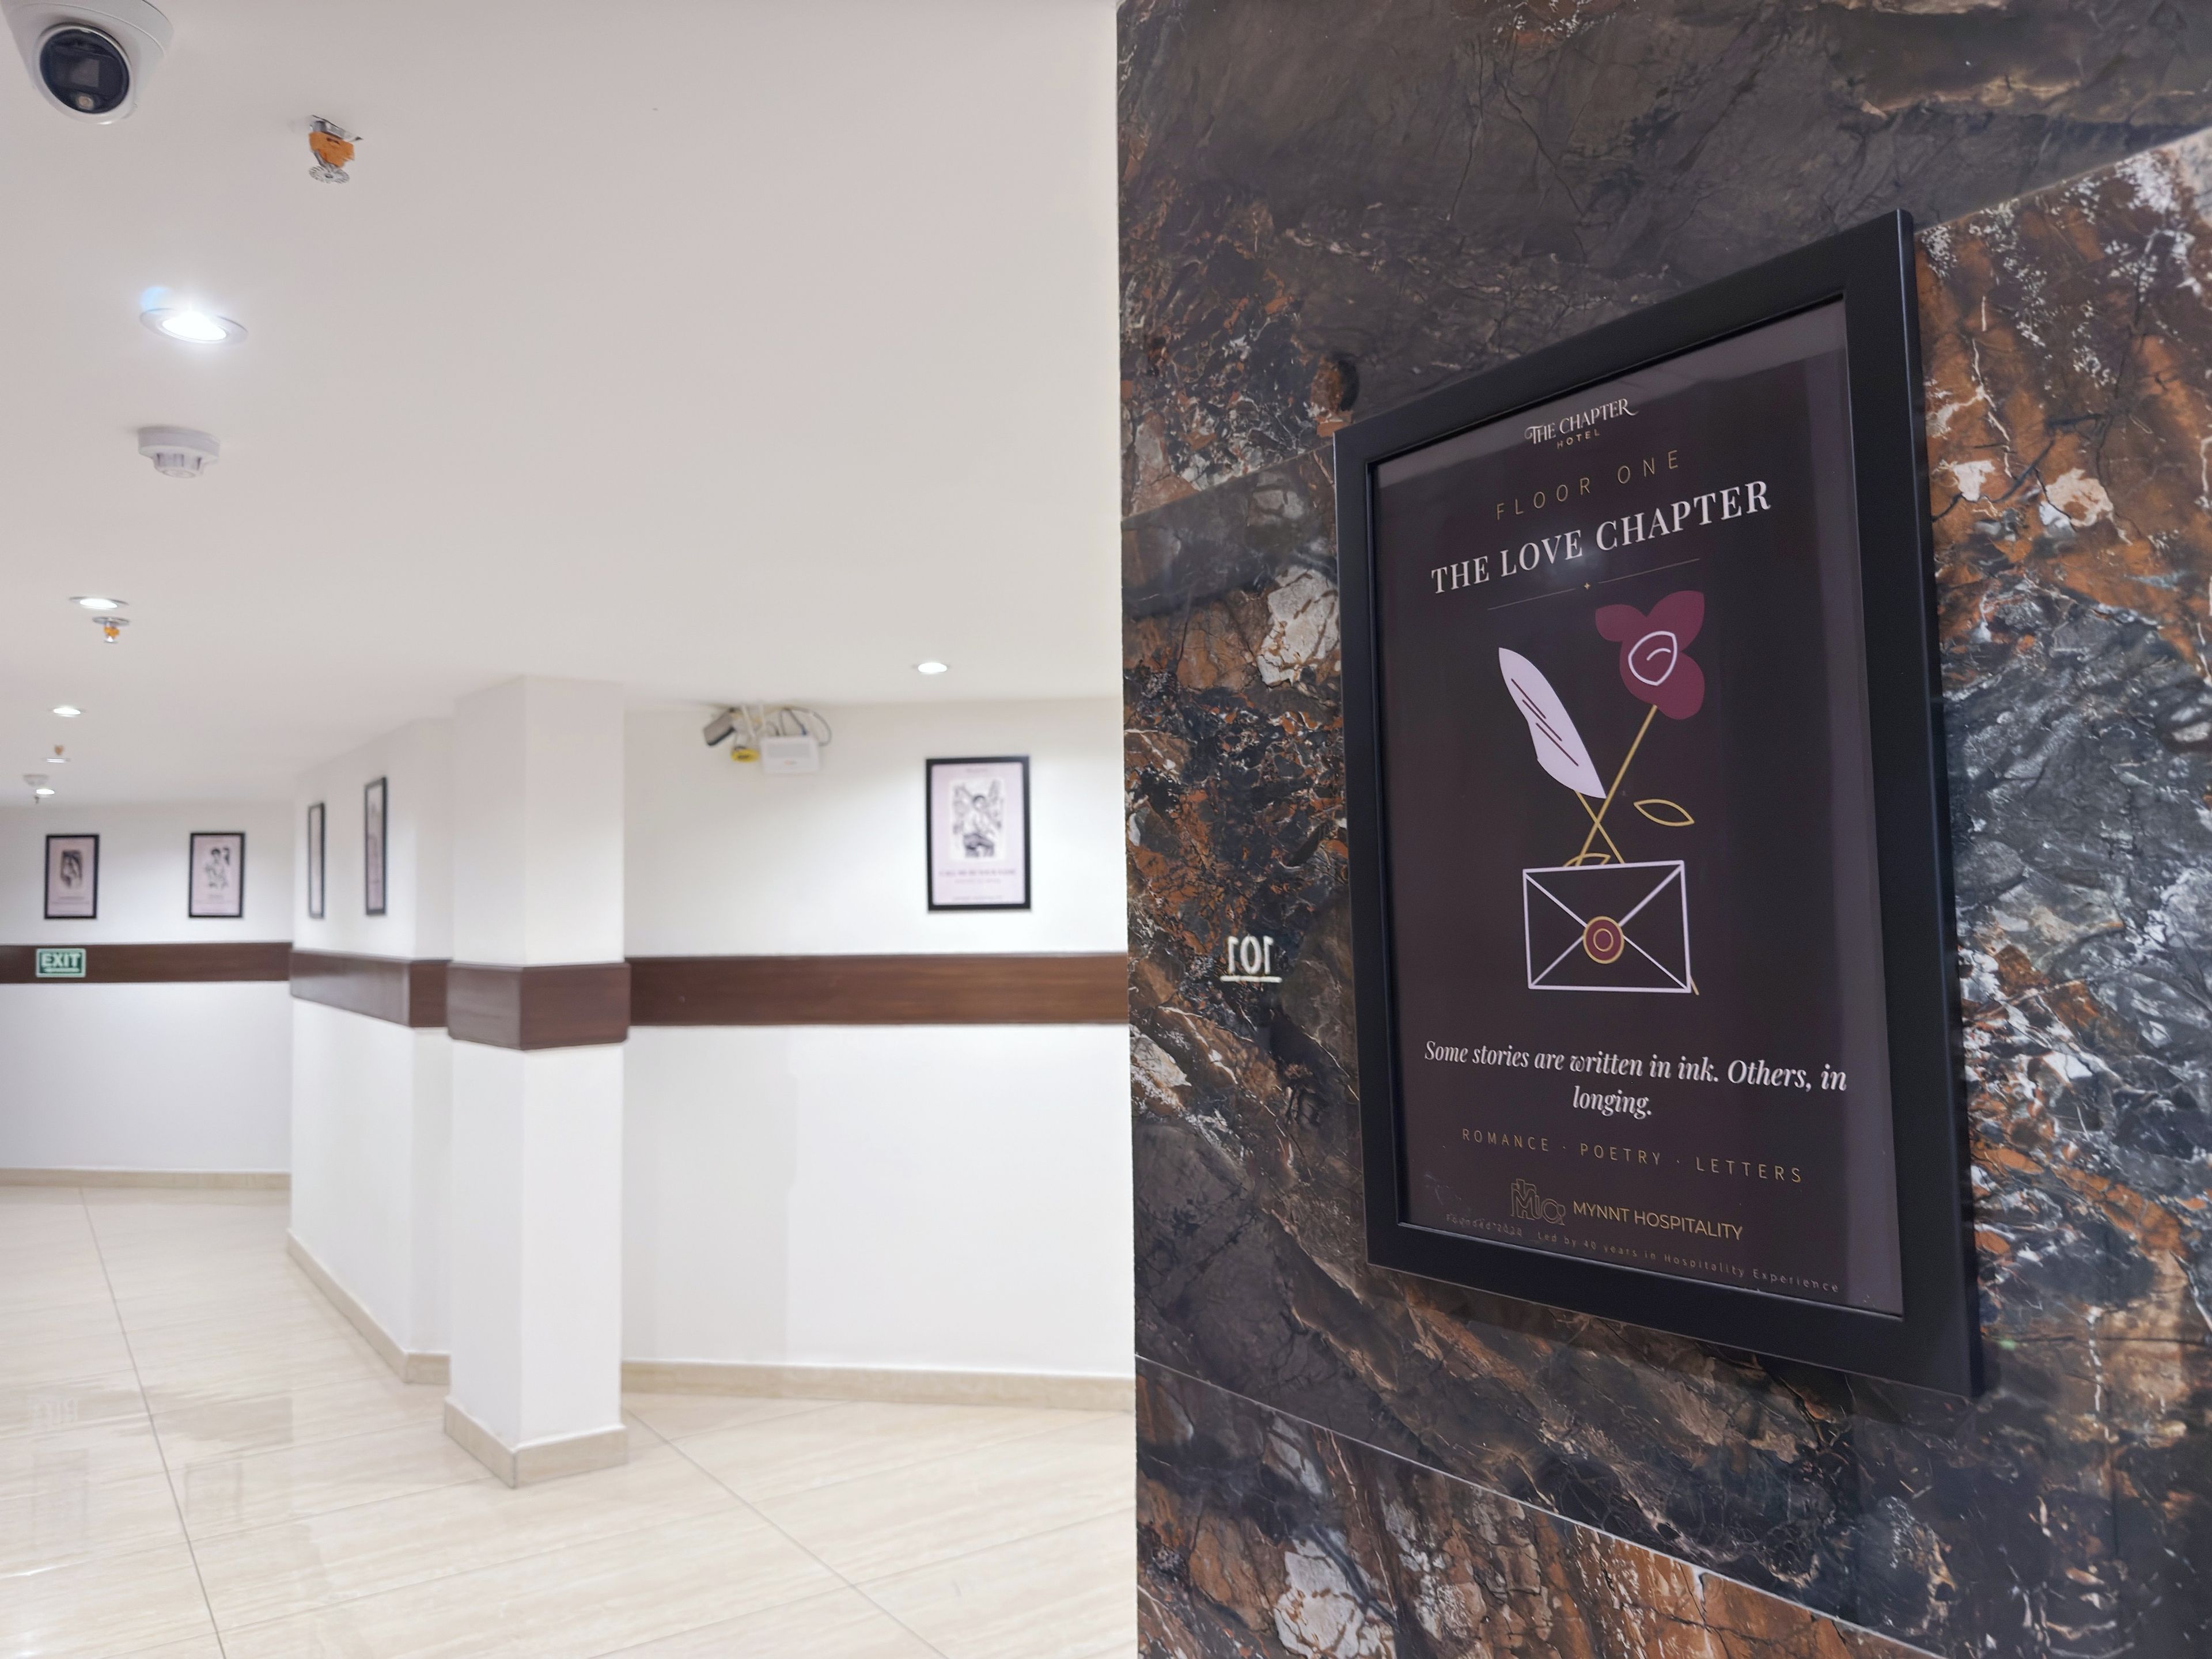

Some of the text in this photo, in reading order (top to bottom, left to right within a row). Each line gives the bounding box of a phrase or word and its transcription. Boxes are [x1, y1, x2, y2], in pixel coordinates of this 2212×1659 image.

[1524, 399, 1639, 445] THE CHAPTER
[1556, 429, 1600, 449] HOTEL
[1497, 450, 1679, 520] FLOOR ONE
[1431, 480, 1772, 594] THE LOVE CHAPTER
[41, 953, 81, 968] EXIT
[1425, 1040, 1847, 1092] Some stories are written in ink. Others, in
[1572, 1085, 1652, 1119] longing.
[1462, 1128, 1802, 1183] ROMANCE POETRY LETTERS
[1573, 1200, 1629, 1222] MYNNT
[1634, 1210, 1743, 1240] HOSPITALITY
[1537, 1232, 1556, 1243] Led
[1564, 1236, 1577, 1248] by
[1603, 1244, 1638, 1257] years
[1644, 1248, 1656, 1260] in
[1664, 1253, 1744, 1278] Hospitality
[1753, 1268, 1839, 1293] Experience
